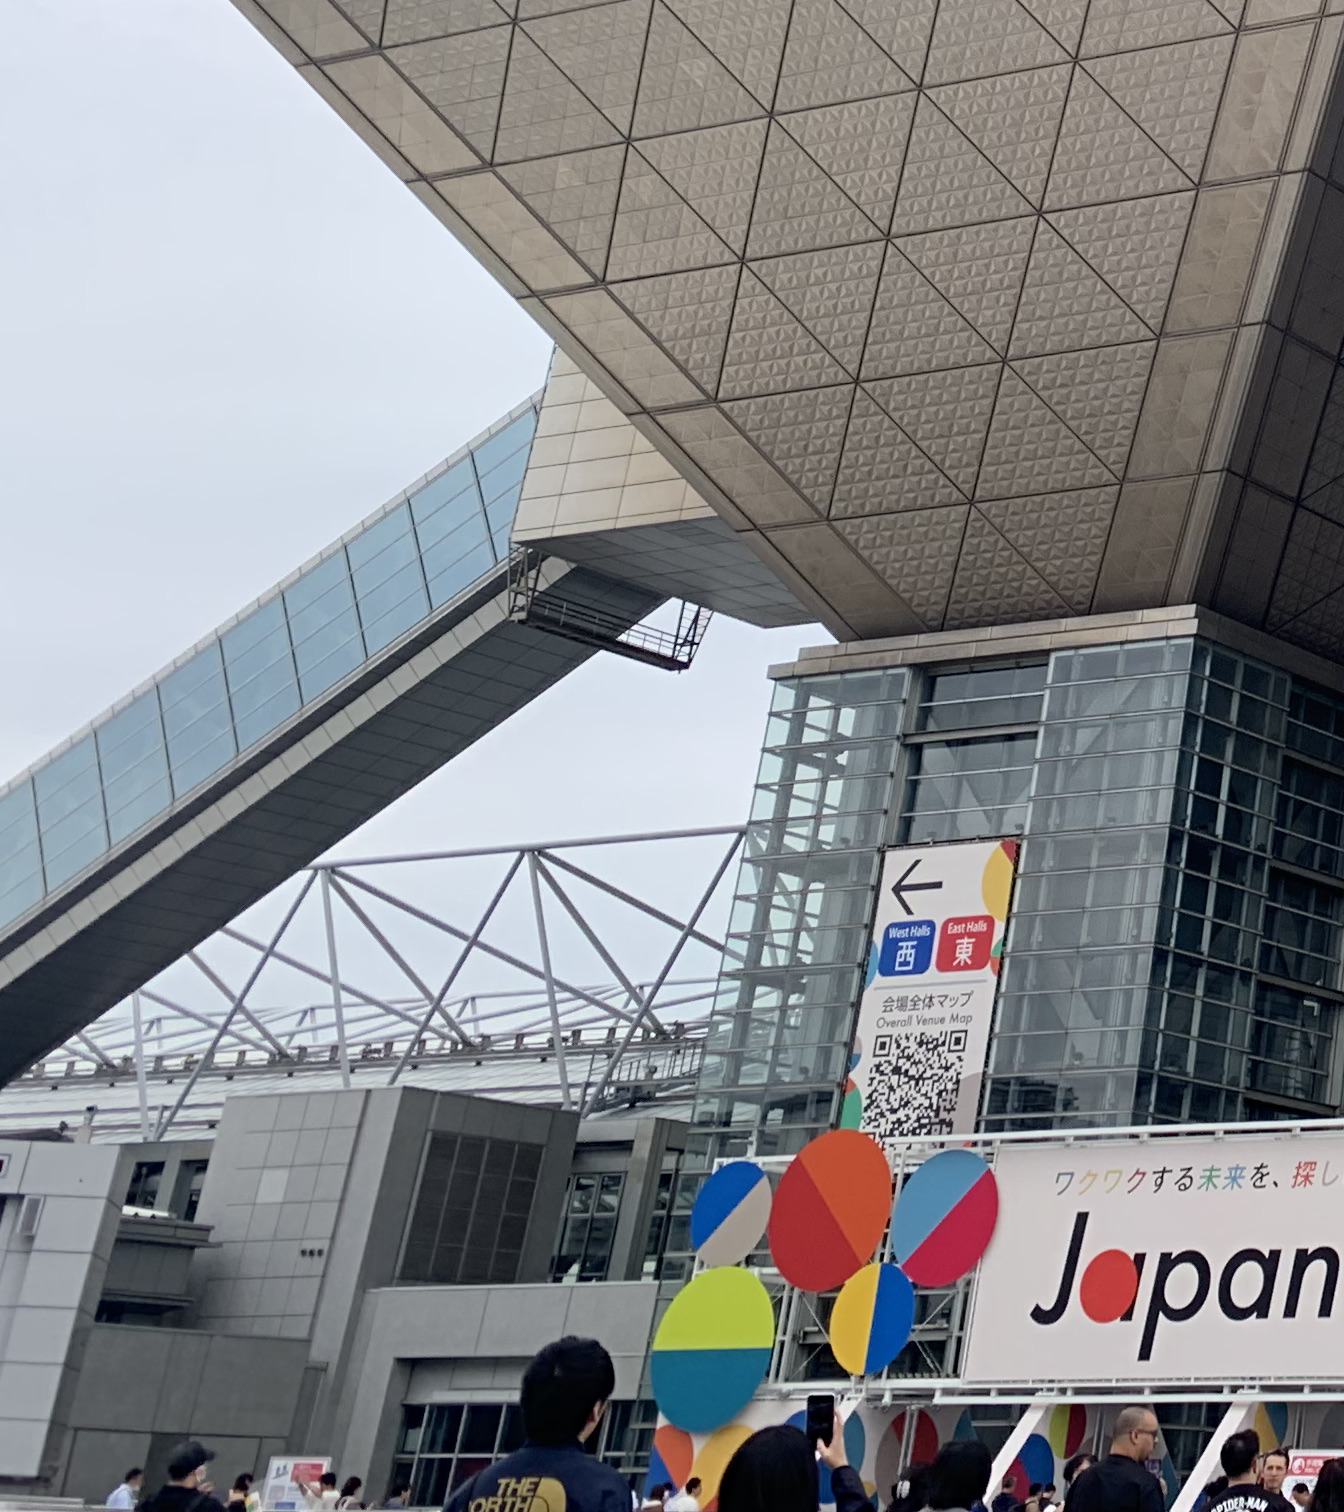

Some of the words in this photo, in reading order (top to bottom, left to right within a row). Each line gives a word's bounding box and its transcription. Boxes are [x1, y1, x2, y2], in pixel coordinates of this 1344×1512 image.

[889, 927, 910, 939] West
[910, 925, 931, 937] Halls
[947, 922, 966, 935] East
[966, 920, 988, 933] Halls
[894, 940, 918, 971] 西
[952, 935, 976, 966] 東
[881, 990, 975, 1014] 会場全体マップ
[876, 1013, 912, 1029] Overall
[916, 1014, 946, 1026] Venue
[949, 1012, 973, 1026] Map
[1029, 1211, 1340, 1362] Japan
[497, 1478, 540, 1496] THE
[469, 1497, 532, 1512] ORTH
